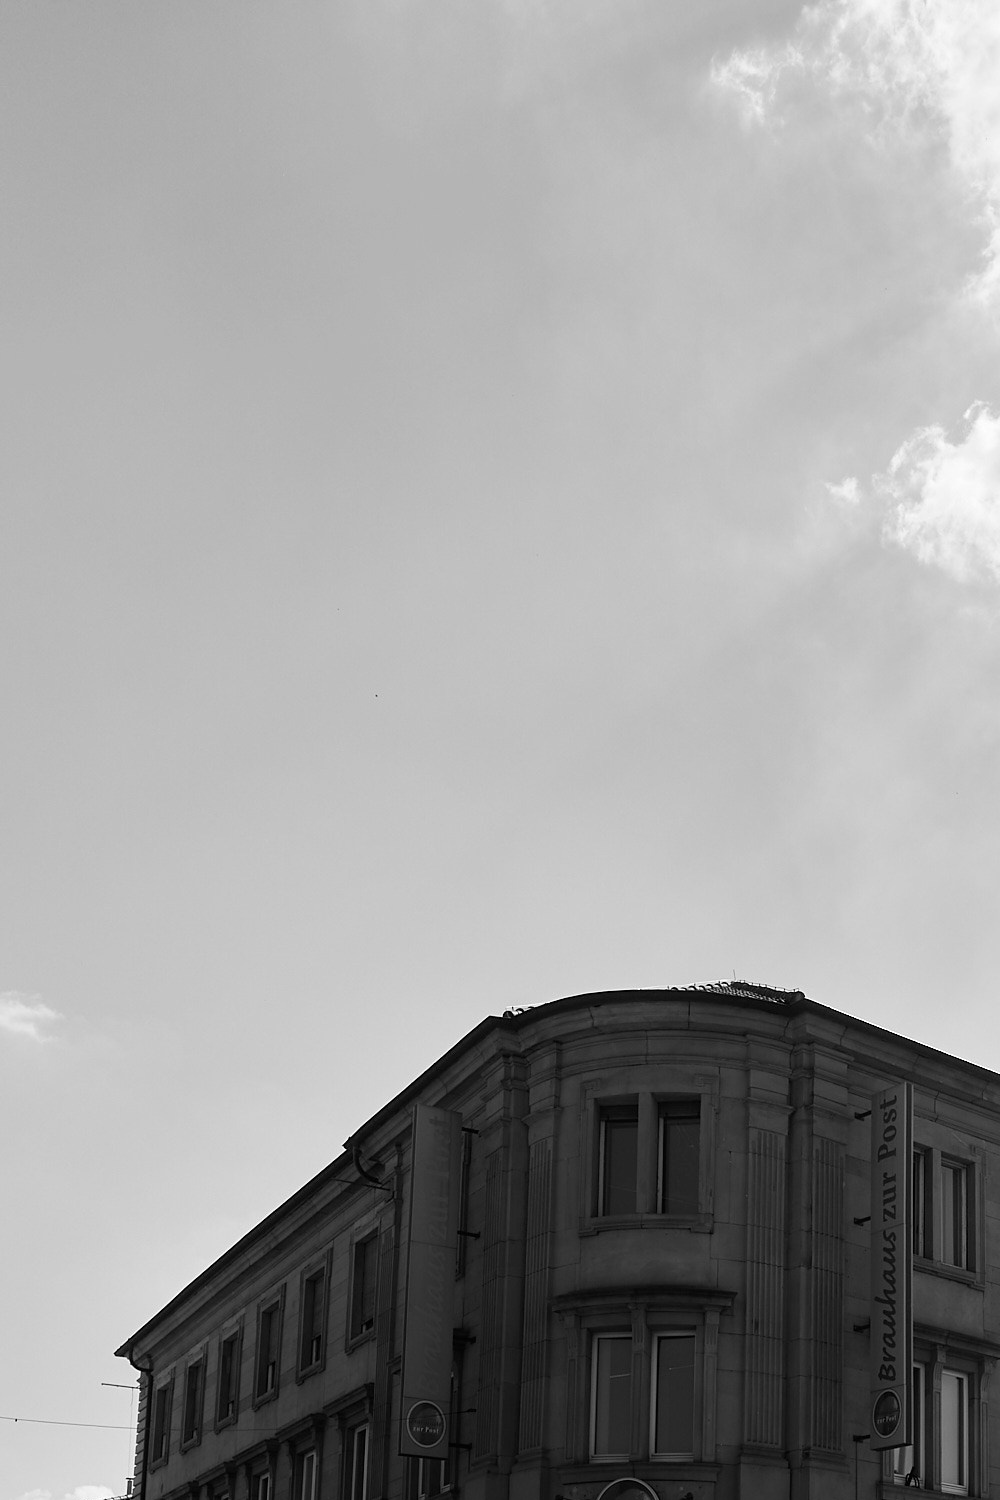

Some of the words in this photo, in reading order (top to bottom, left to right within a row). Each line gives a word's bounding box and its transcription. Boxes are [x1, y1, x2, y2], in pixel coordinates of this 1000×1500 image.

[877, 1094, 899, 1162] Post
[882, 1171, 898, 1223] zur
[874, 1229, 898, 1382] Brauhaus
